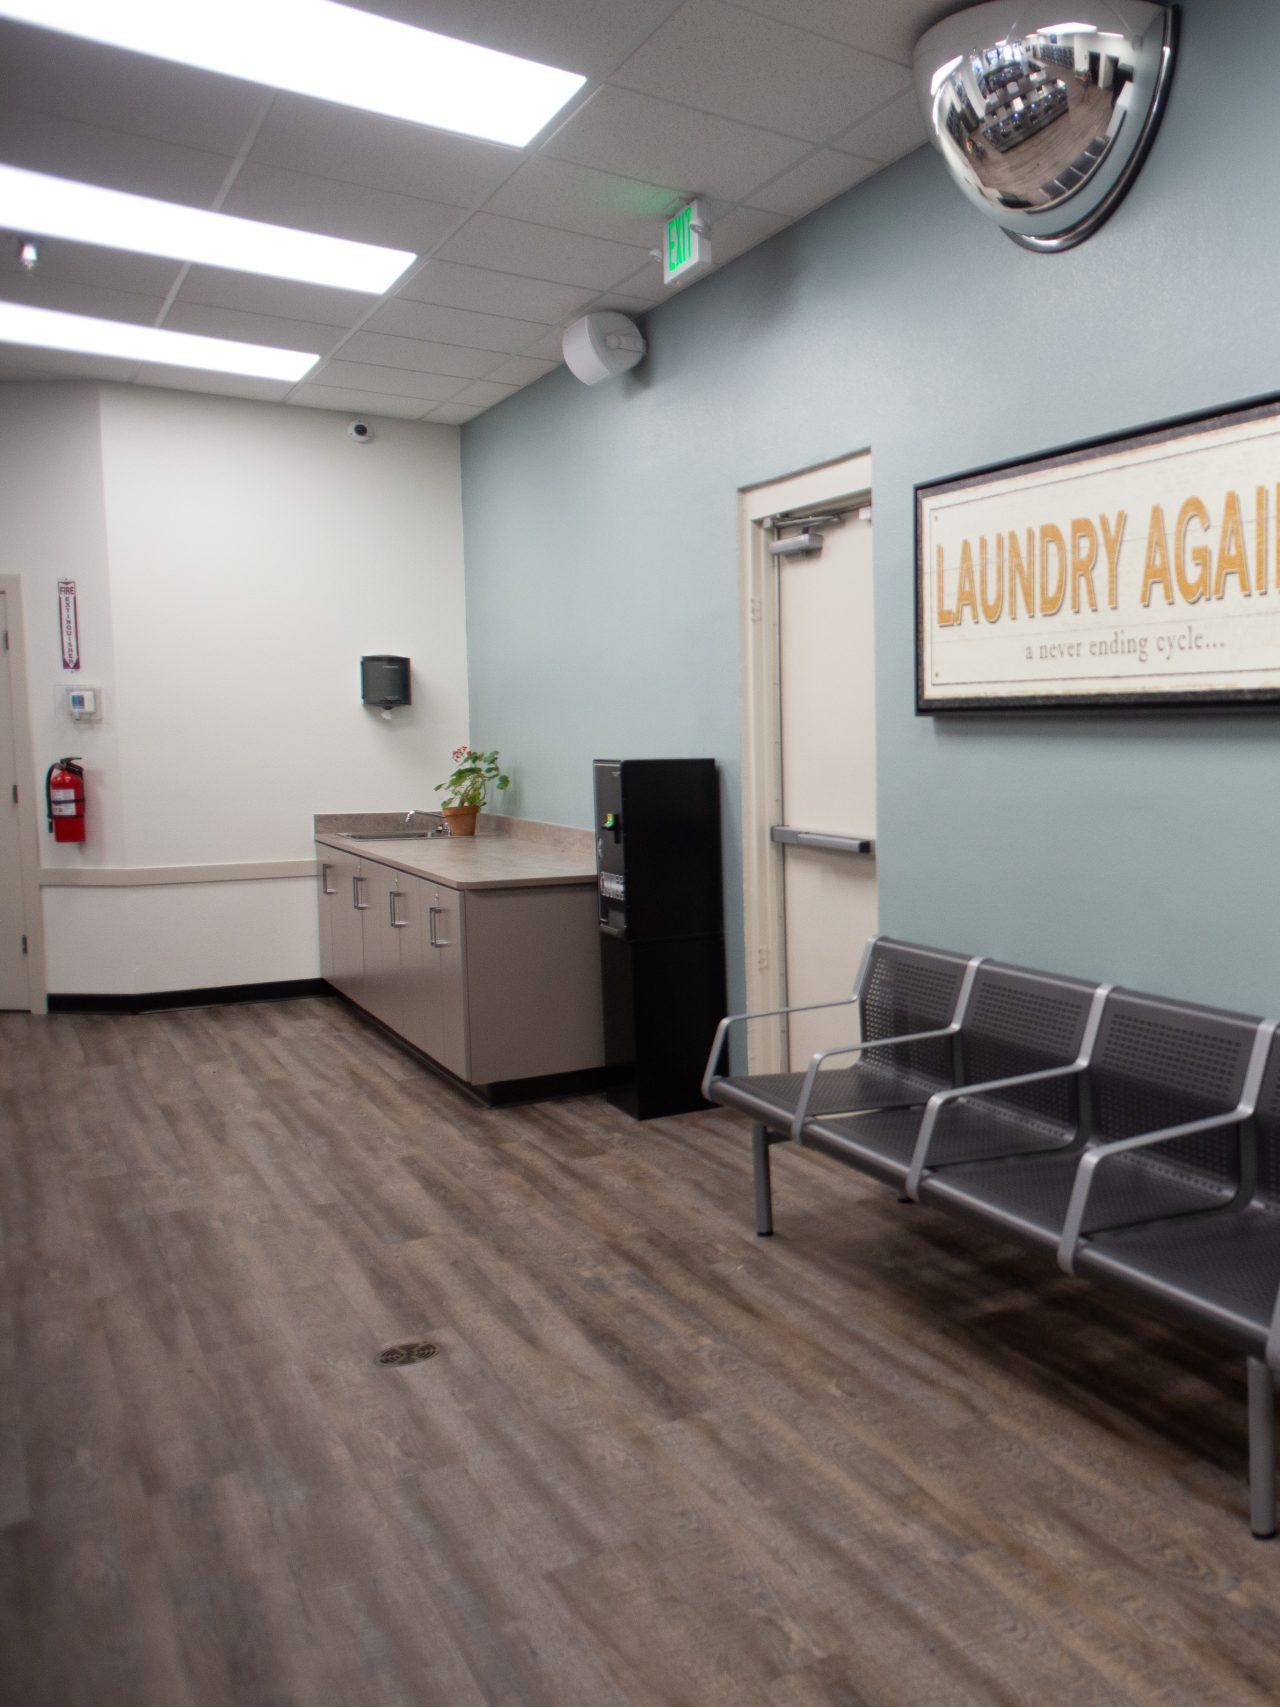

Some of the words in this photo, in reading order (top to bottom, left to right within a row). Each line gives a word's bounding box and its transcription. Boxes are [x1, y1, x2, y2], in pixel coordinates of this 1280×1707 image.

[669, 207, 692, 272] EXIT
[60, 586, 75, 595] FIRE
[936, 509, 1128, 628] LAUNDRY
[65, 596, 74, 664] EXTINGUISHER
[1025, 645, 1033, 660] a
[1039, 641, 1082, 660] never
[1089, 630, 1148, 663] ending
[1156, 625, 1226, 660] cycle...
